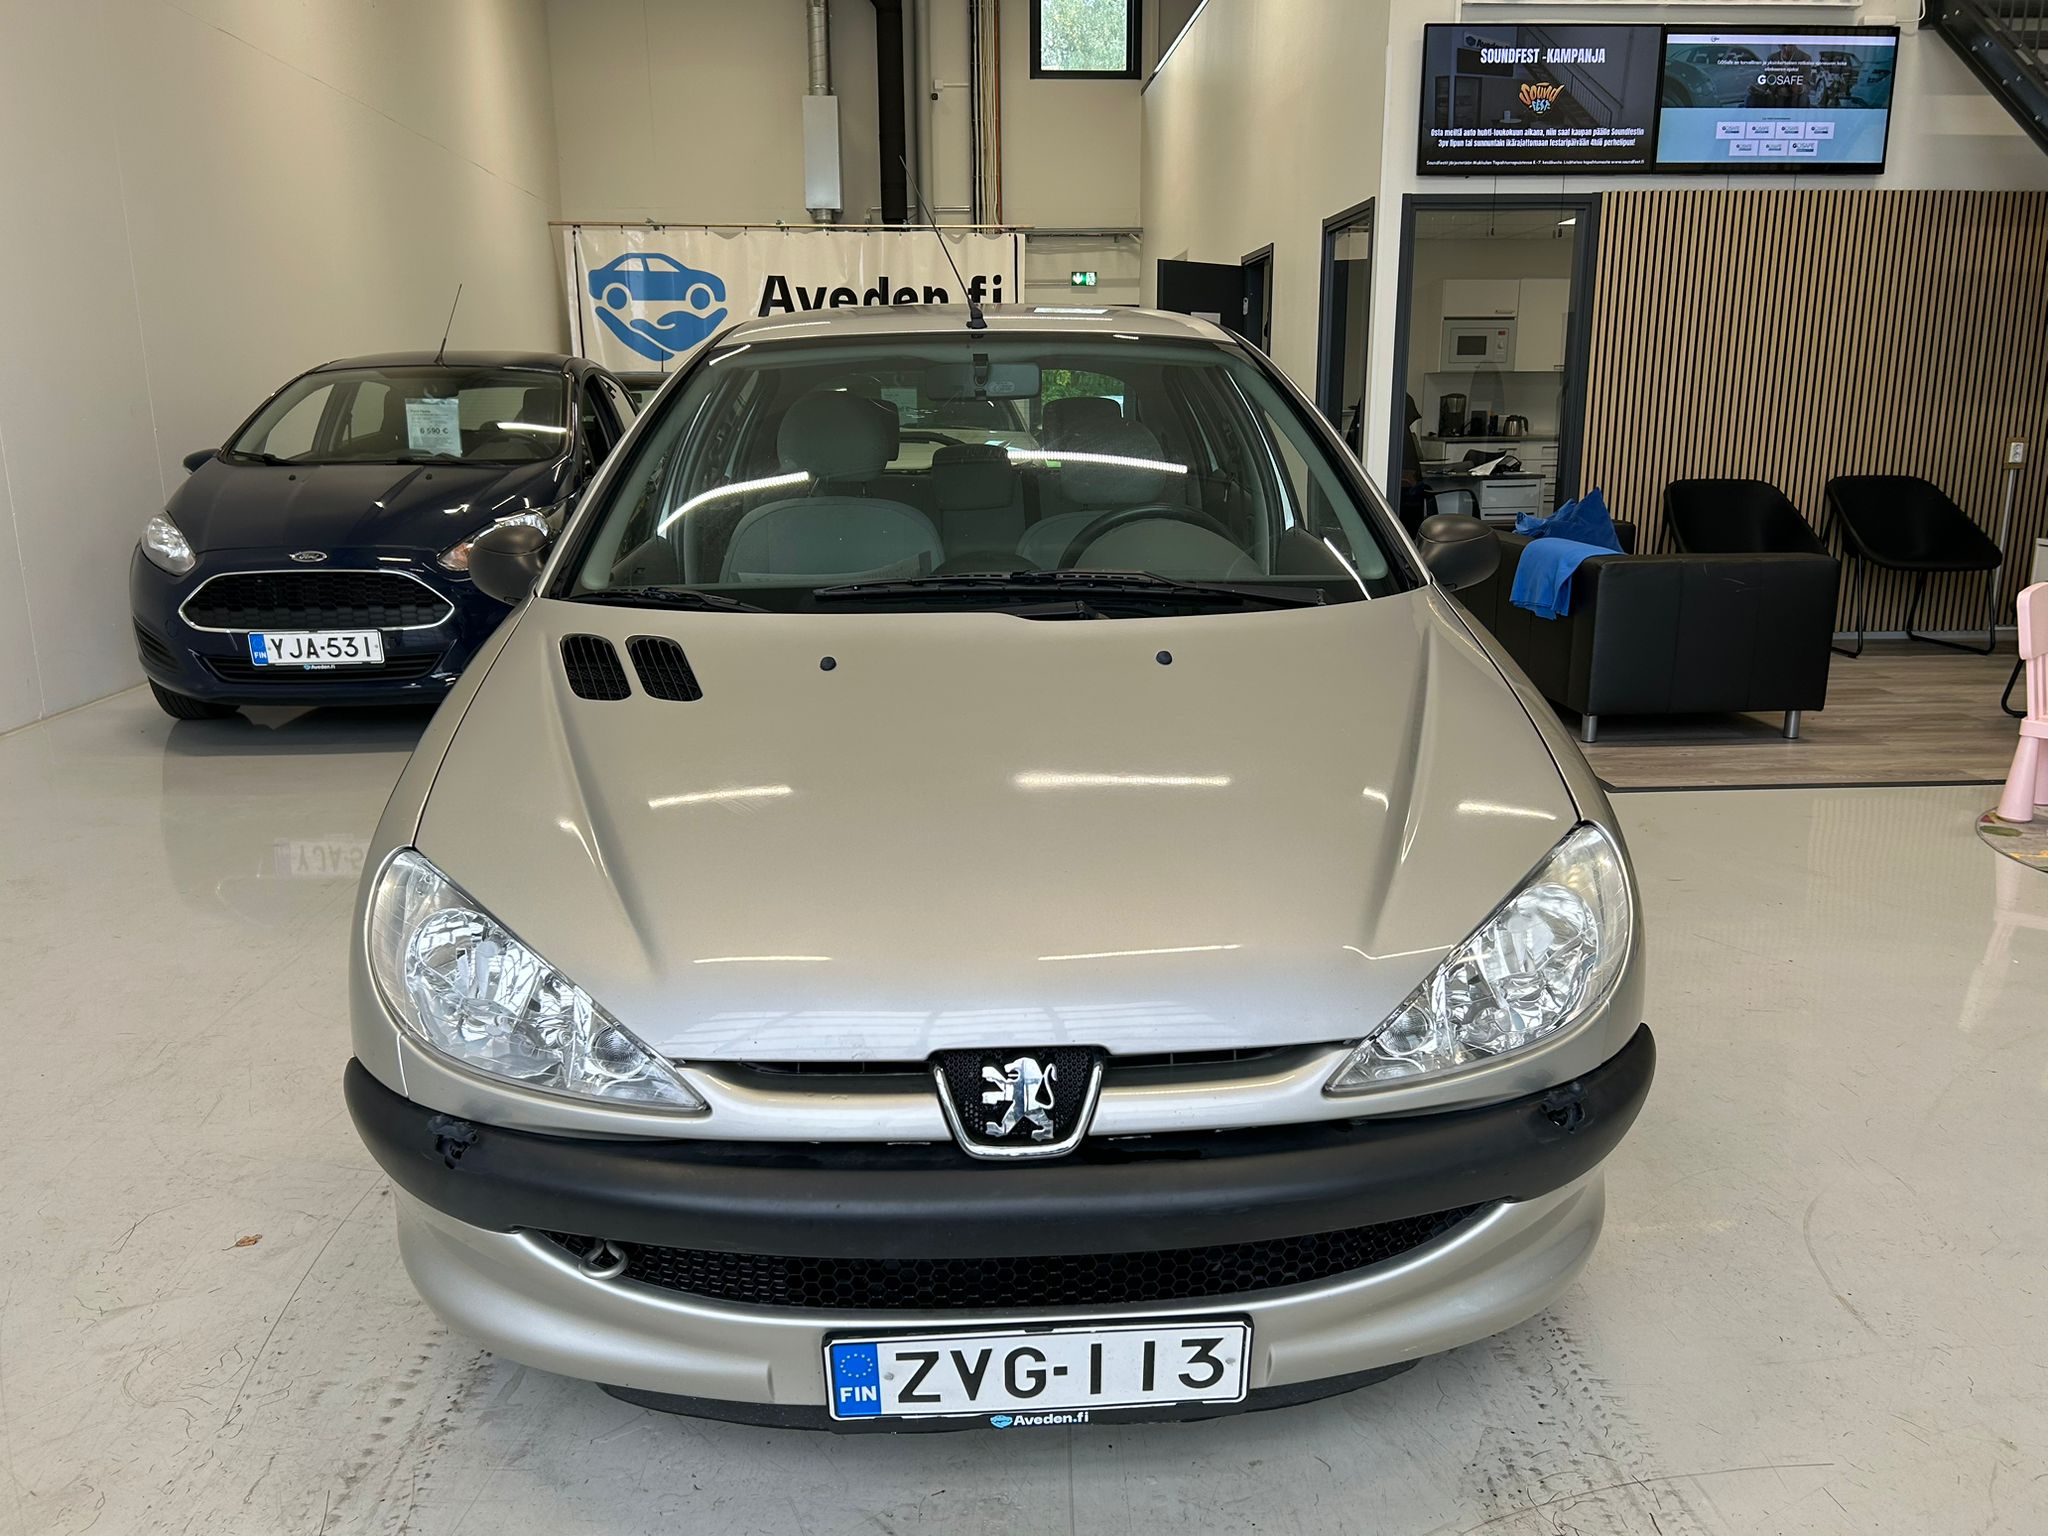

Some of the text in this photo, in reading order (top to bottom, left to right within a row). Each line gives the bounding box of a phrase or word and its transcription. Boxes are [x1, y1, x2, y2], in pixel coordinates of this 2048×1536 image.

[1480, 47, 1605, 64] SOUNDFEST -KAMPANJA
[1757, 74, 1804, 86] GOSAFE
[1444, 128, 1462, 136] meiltä
[1477, 128, 1523, 136] huhti-toukokuun
[1546, 128, 1556, 136] niin
[1558, 128, 1570, 136] saat
[1571, 128, 1592, 137] kaupan
[1611, 128, 1644, 136] Soundfestin
[1438, 139, 1449, 148] 3pv
[1465, 139, 1473, 147] tai
[1474, 139, 1505, 147] sunnuntain
[758, 274, 1002, 318] Avedenfi
[254, 651, 267, 660] FIN
[270, 637, 371, 659] YJA-531
[894, 1337, 1225, 1404] ZVG-113
[839, 1386, 878, 1403] FIN
[1013, 1412, 1090, 1426] Aveden.fi
